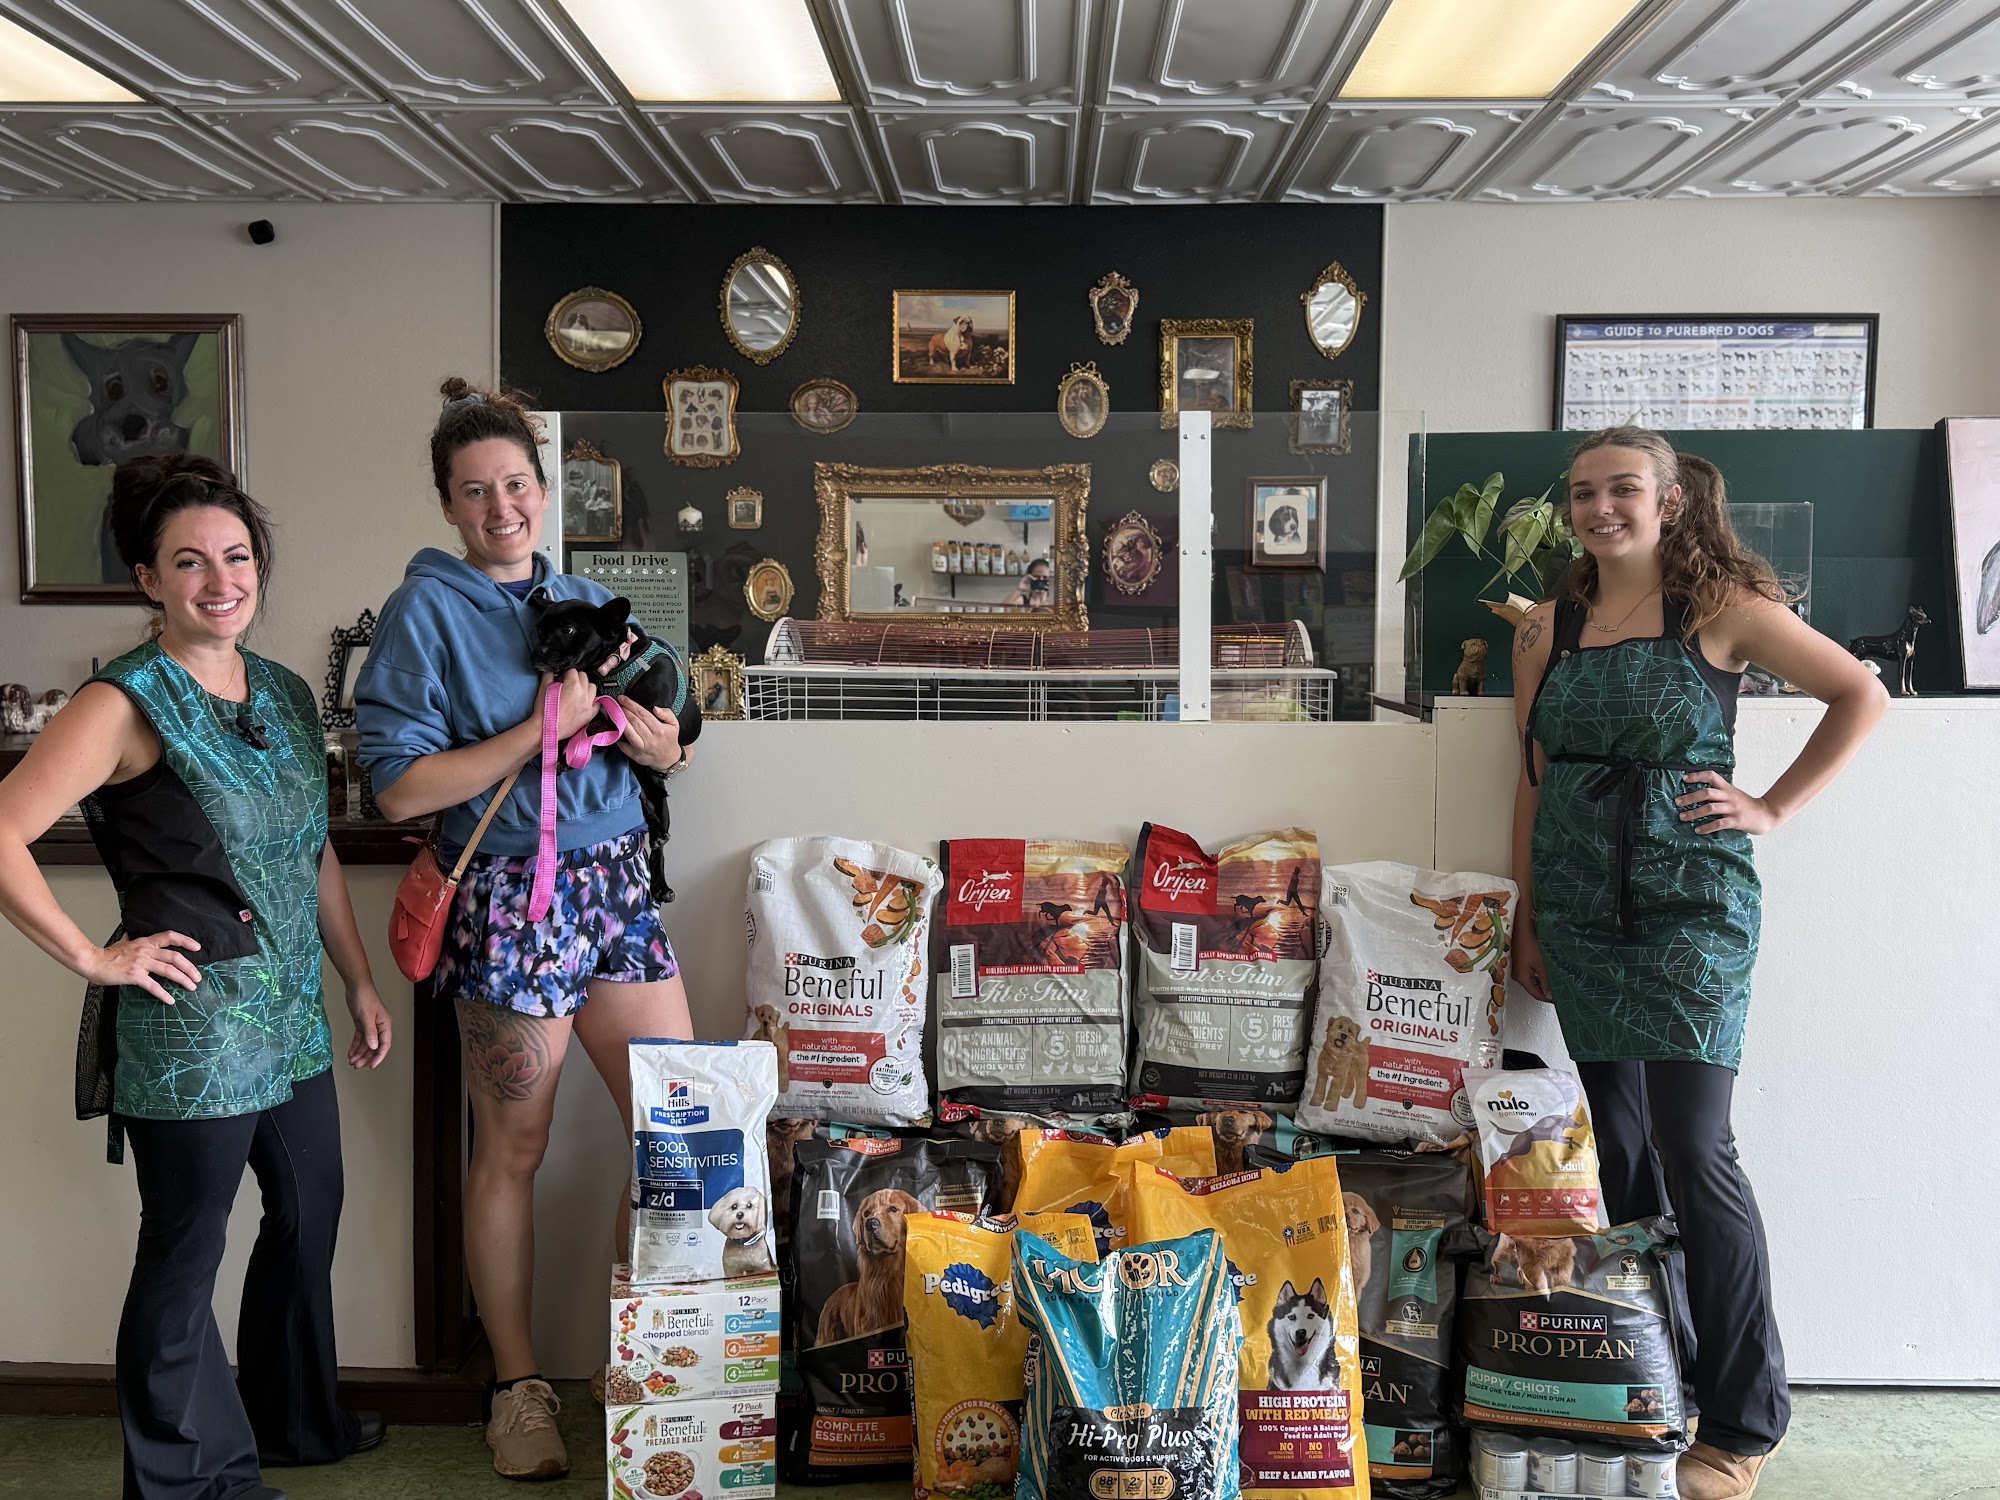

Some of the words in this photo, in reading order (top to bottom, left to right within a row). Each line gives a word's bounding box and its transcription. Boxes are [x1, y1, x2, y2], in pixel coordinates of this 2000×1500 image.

[1604, 326, 1644, 336] GUIDE
[1666, 326, 1733, 336] PUREBRED
[1738, 326, 1774, 336] DOGS
[593, 555, 624, 566] Food
[632, 555, 668, 566] Drive
[1153, 862, 1206, 901] Orijen
[958, 879, 1011, 912] Orijen
[800, 956, 853, 969] PURINA
[1216, 952, 1249, 961] APPROPRIATE
[985, 967, 1019, 975] BIOLOGICALLY
[1229, 963, 1285, 987] Trim
[784, 966, 884, 1000] Beneful
[1380, 975, 1440, 991] PURINA
[974, 979, 1011, 1003] Fit
[1030, 978, 1090, 1002] Trim
[789, 1003, 873, 1017] ORIGINALS
[1366, 981, 1472, 1027] Beneful
[1179, 1010, 1212, 1025] ANIMAL
[1248, 1018, 1263, 1038] 5
[1370, 1017, 1459, 1044] ORIGINALS
[981, 1033, 1014, 1045] ANIMAL
[1076, 1031, 1101, 1043] FRESH
[1272, 1029, 1282, 1041] OR
[830, 1044, 856, 1052] salmon
[1049, 1036, 1064, 1055] 5
[1169, 1038, 1222, 1050] WHOLEPREY
[971, 1047, 1026, 1060] INGREDIENTS
[1076, 1045, 1086, 1057] OR
[1089, 1044, 1109, 1056] RAW
[821, 1054, 859, 1063] ingredient
[1383, 1061, 1410, 1070] natural
[1412, 1066, 1440, 1075] salmon
[1377, 1070, 1390, 1079] the
[1403, 1074, 1443, 1088] ingredient
[668, 1098, 690, 1108] Hill's
[1487, 1097, 1530, 1112] nulo
[655, 1110, 705, 1118] PRESCRIPTION
[1380, 1107, 1409, 1116] omega-rich
[1380, 1124, 1395, 1132] adult
[649, 1141, 688, 1153] FOOD
[649, 1154, 738, 1168] SENSITIVITIES
[1558, 1160, 1586, 1172] adult
[650, 1192, 675, 1207] z/d
[1297, 1226, 1310, 1234] USA
[924, 1274, 1012, 1304] Pedigree
[739, 1296, 751, 1306] 12
[668, 1313, 709, 1329] Beneful
[1541, 1316, 1603, 1330] PURINA
[643, 1330, 681, 1339] chopped
[730, 1345, 737, 1353] 4
[1491, 1329, 1552, 1356] PRO
[1557, 1337, 1637, 1360] PLAN
[730, 1370, 737, 1378] 4
[840, 1372, 898, 1394] PRO
[1470, 1370, 1505, 1388] PUPPY
[1513, 1381, 1560, 1395] CHIOTS
[1469, 1381, 1488, 1392] UNDER
[1489, 1386, 1502, 1394] ONE
[1503, 1389, 1521, 1398] YEAR
[1526, 1392, 1548, 1401] MOINS
[1549, 1395, 1566, 1403] D'UN
[732, 1403, 744, 1413] 12
[745, 1402, 763, 1410] Pack
[1258, 1396, 1291, 1408] HIGH
[1293, 1396, 1347, 1408] PROTEIN
[1491, 1401, 1507, 1409] BLEND
[1245, 1409, 1283, 1420] WITH
[1285, 1409, 1309, 1420] RED
[1312, 1409, 1347, 1420] MEAT
[1467, 1408, 1490, 1418] CHICKEN
[1510, 1415, 1538, 1423] FORMULA
[661, 1421, 703, 1437] Beneful
[733, 1427, 740, 1436] 4
[815, 1420, 879, 1431] COMPLETE
[936, 1425, 945, 1452] SMALL
[943, 1405, 963, 1424] PIECES
[963, 1400, 978, 1408] FOR
[979, 1400, 1003, 1416] SMALL
[1003, 1414, 1019, 1445] MOUTHS
[646, 1437, 679, 1446] PREPARED
[815, 1431, 886, 1442] ESSENTIALS
[1068, 1422, 1139, 1449] Hi-Pro
[1146, 1422, 1193, 1448] Plus
[1279, 1442, 1294, 1450] NO
[1309, 1442, 1323, 1450] NO
[733, 1451, 739, 1460] 4
[733, 1474, 740, 1484] 4
[1259, 1471, 1281, 1479] BEEF
[1291, 1471, 1317, 1479] LAMB
[1318, 1470, 1350, 1479] FLAVOR
[1485, 1490, 1499, 1499] 7018
